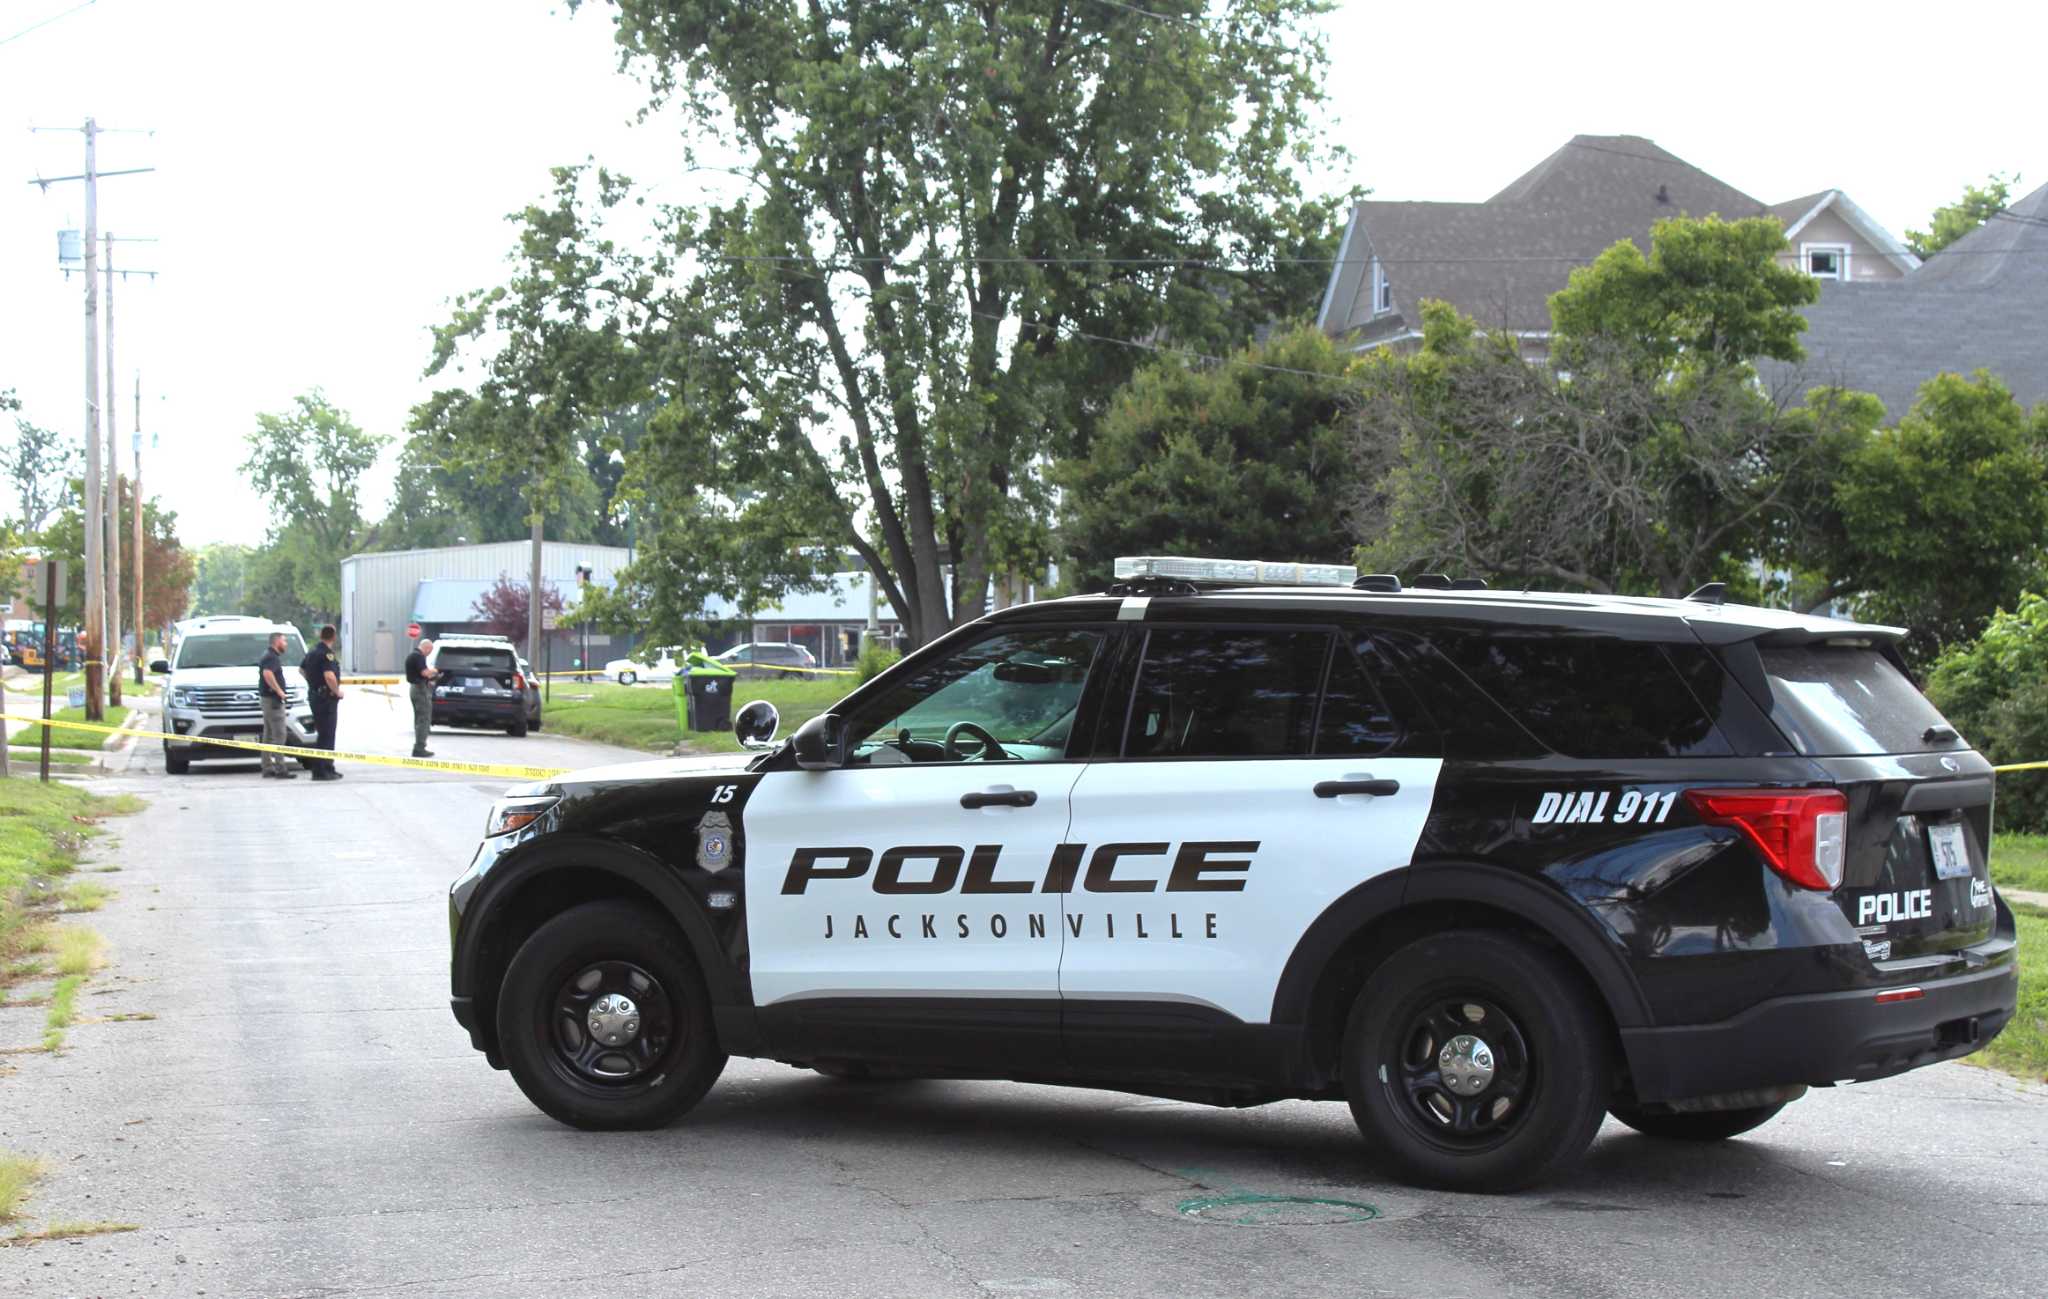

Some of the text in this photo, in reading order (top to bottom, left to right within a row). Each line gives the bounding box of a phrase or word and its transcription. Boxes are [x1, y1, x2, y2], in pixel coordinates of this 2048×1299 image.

[710, 785, 738, 803] 15
[1531, 791, 1677, 824] DIAL 911
[780, 841, 1261, 895] POLICE
[1858, 889, 1932, 925] POLICE
[825, 913, 1218, 939] JACKSONVILLE
